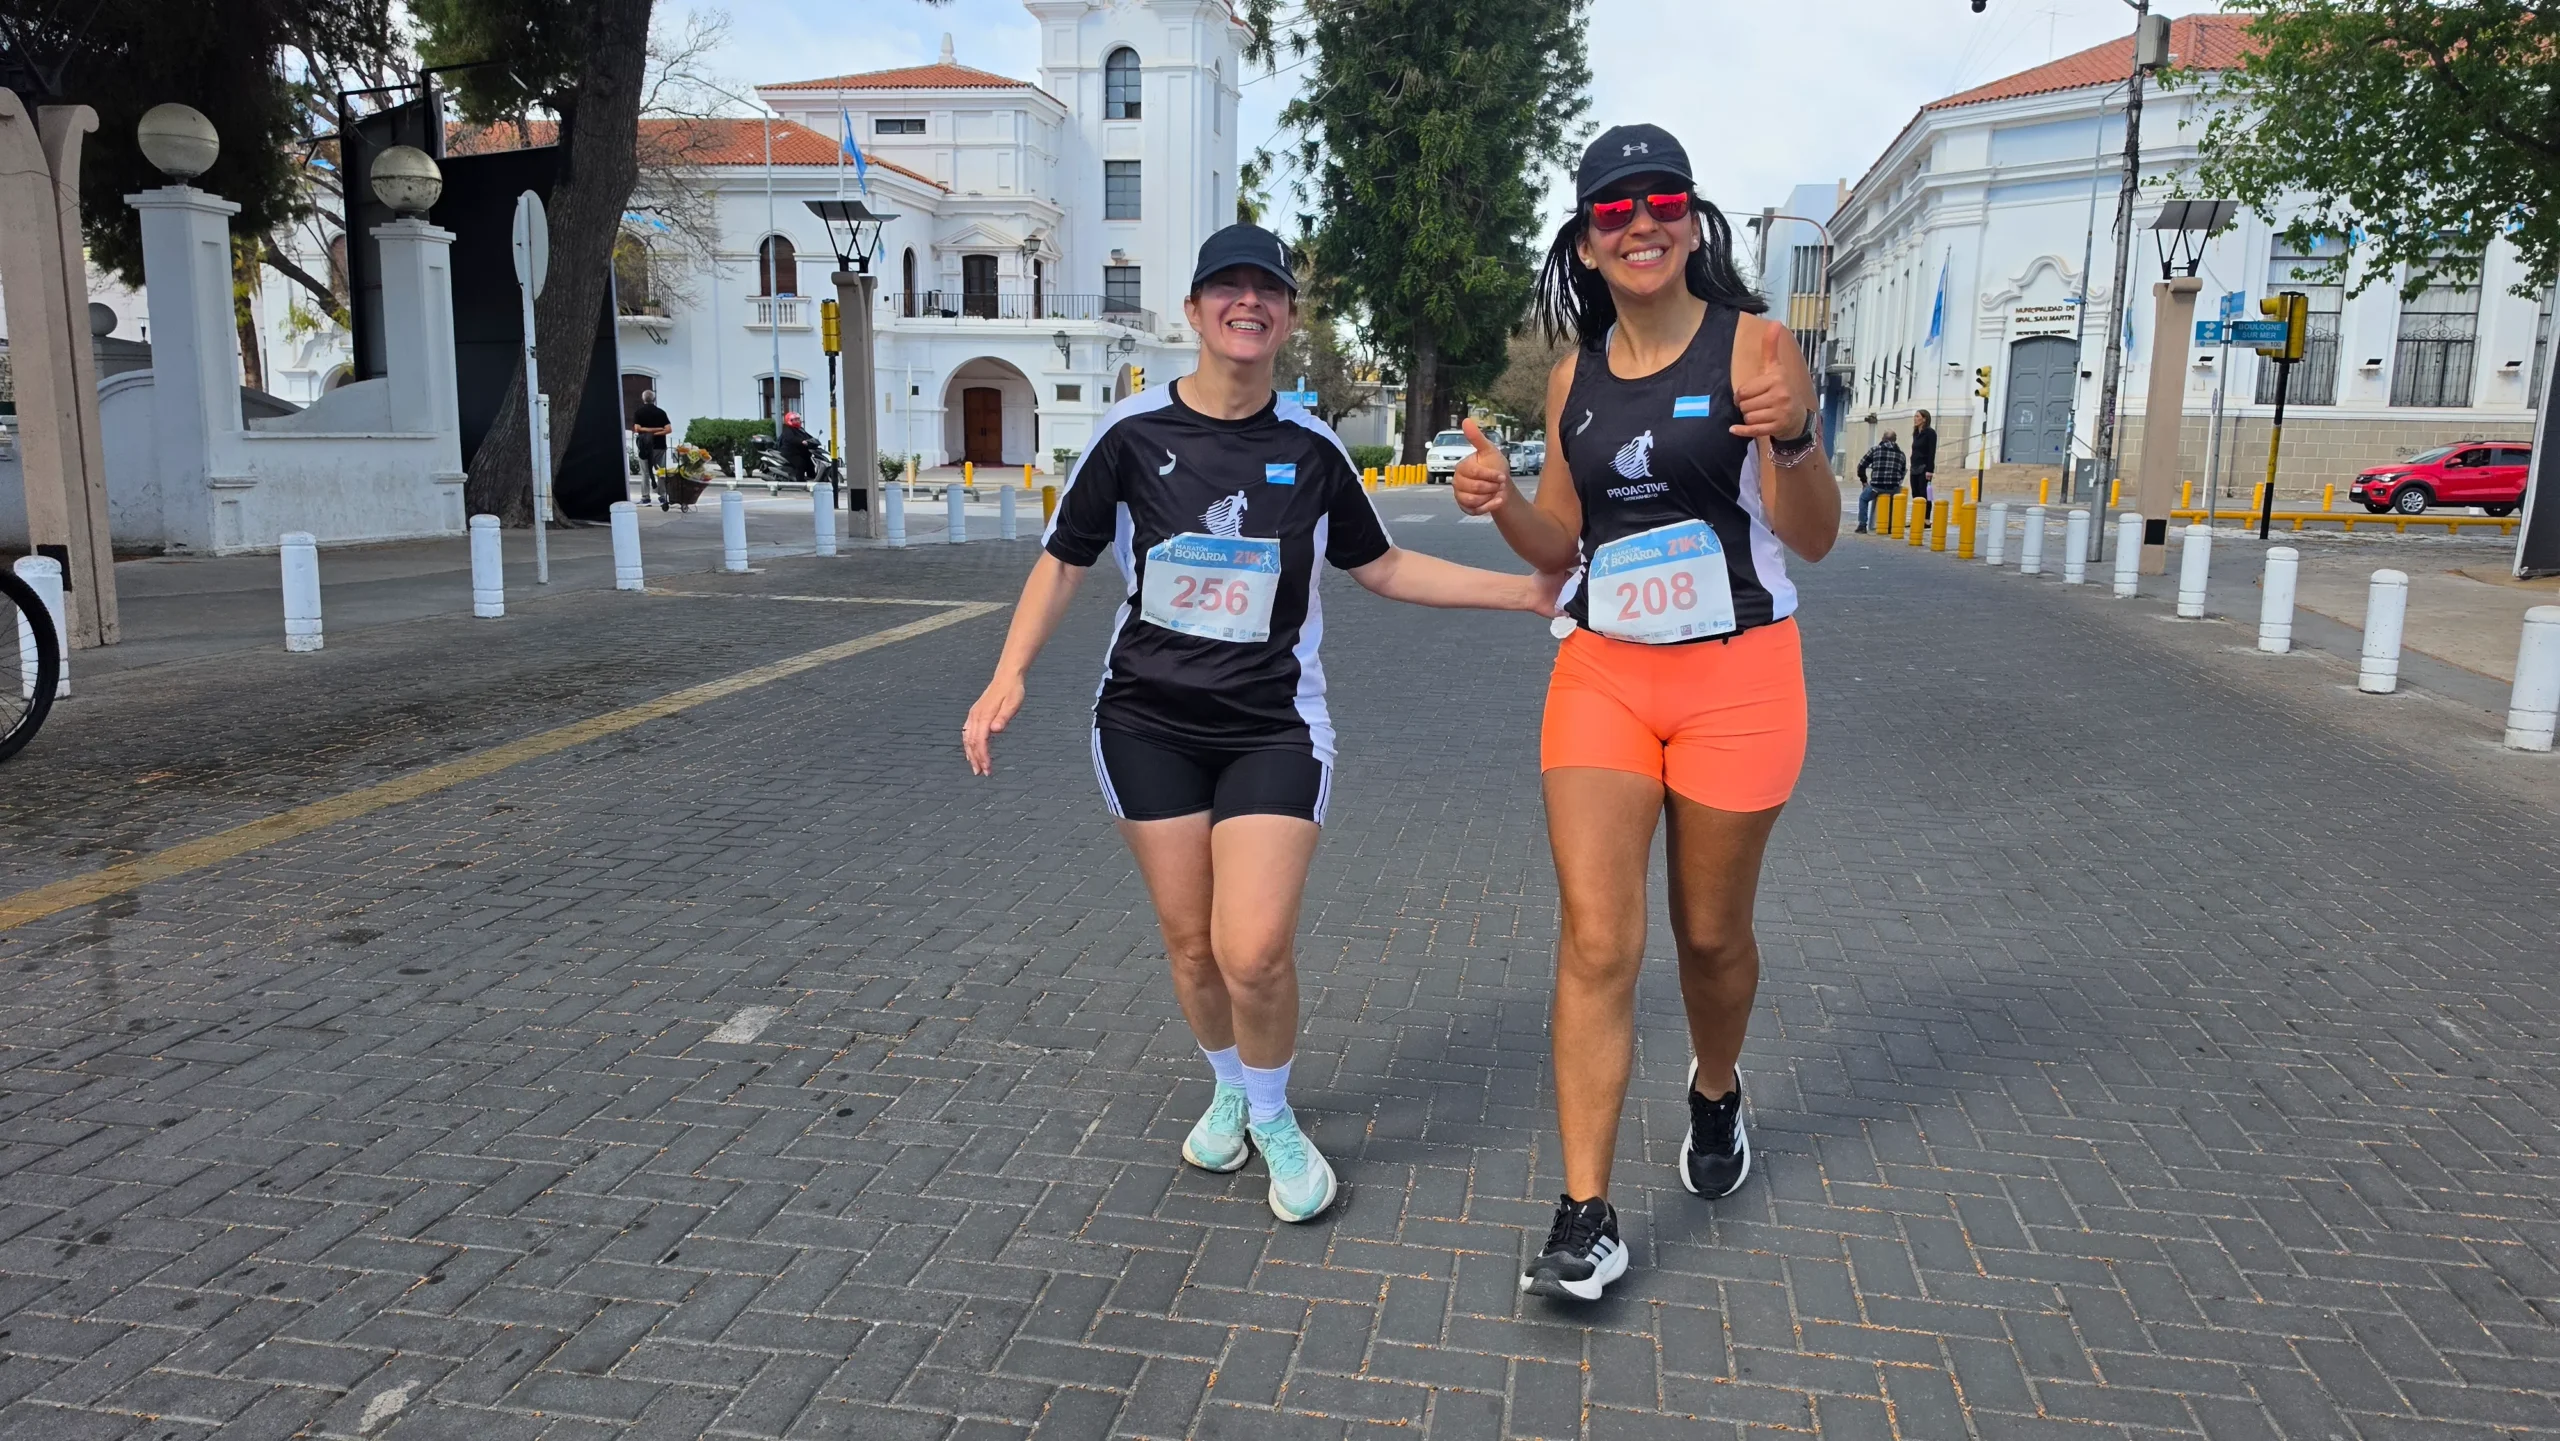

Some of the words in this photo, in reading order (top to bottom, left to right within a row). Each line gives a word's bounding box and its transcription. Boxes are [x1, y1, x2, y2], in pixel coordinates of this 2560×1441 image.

[2238, 323, 2282, 331] BOULOGNE
[1606, 482, 1670, 498] PROACTIVE
[1175, 543, 1209, 552] MARATÓN
[1611, 547, 1663, 568] BONARDA
[1667, 535, 1700, 556] 21K
[1174, 550, 1228, 562] BONARDA
[1233, 551, 1261, 565] 21K
[1170, 575, 1249, 616] 256
[1616, 572, 1698, 622] 208
